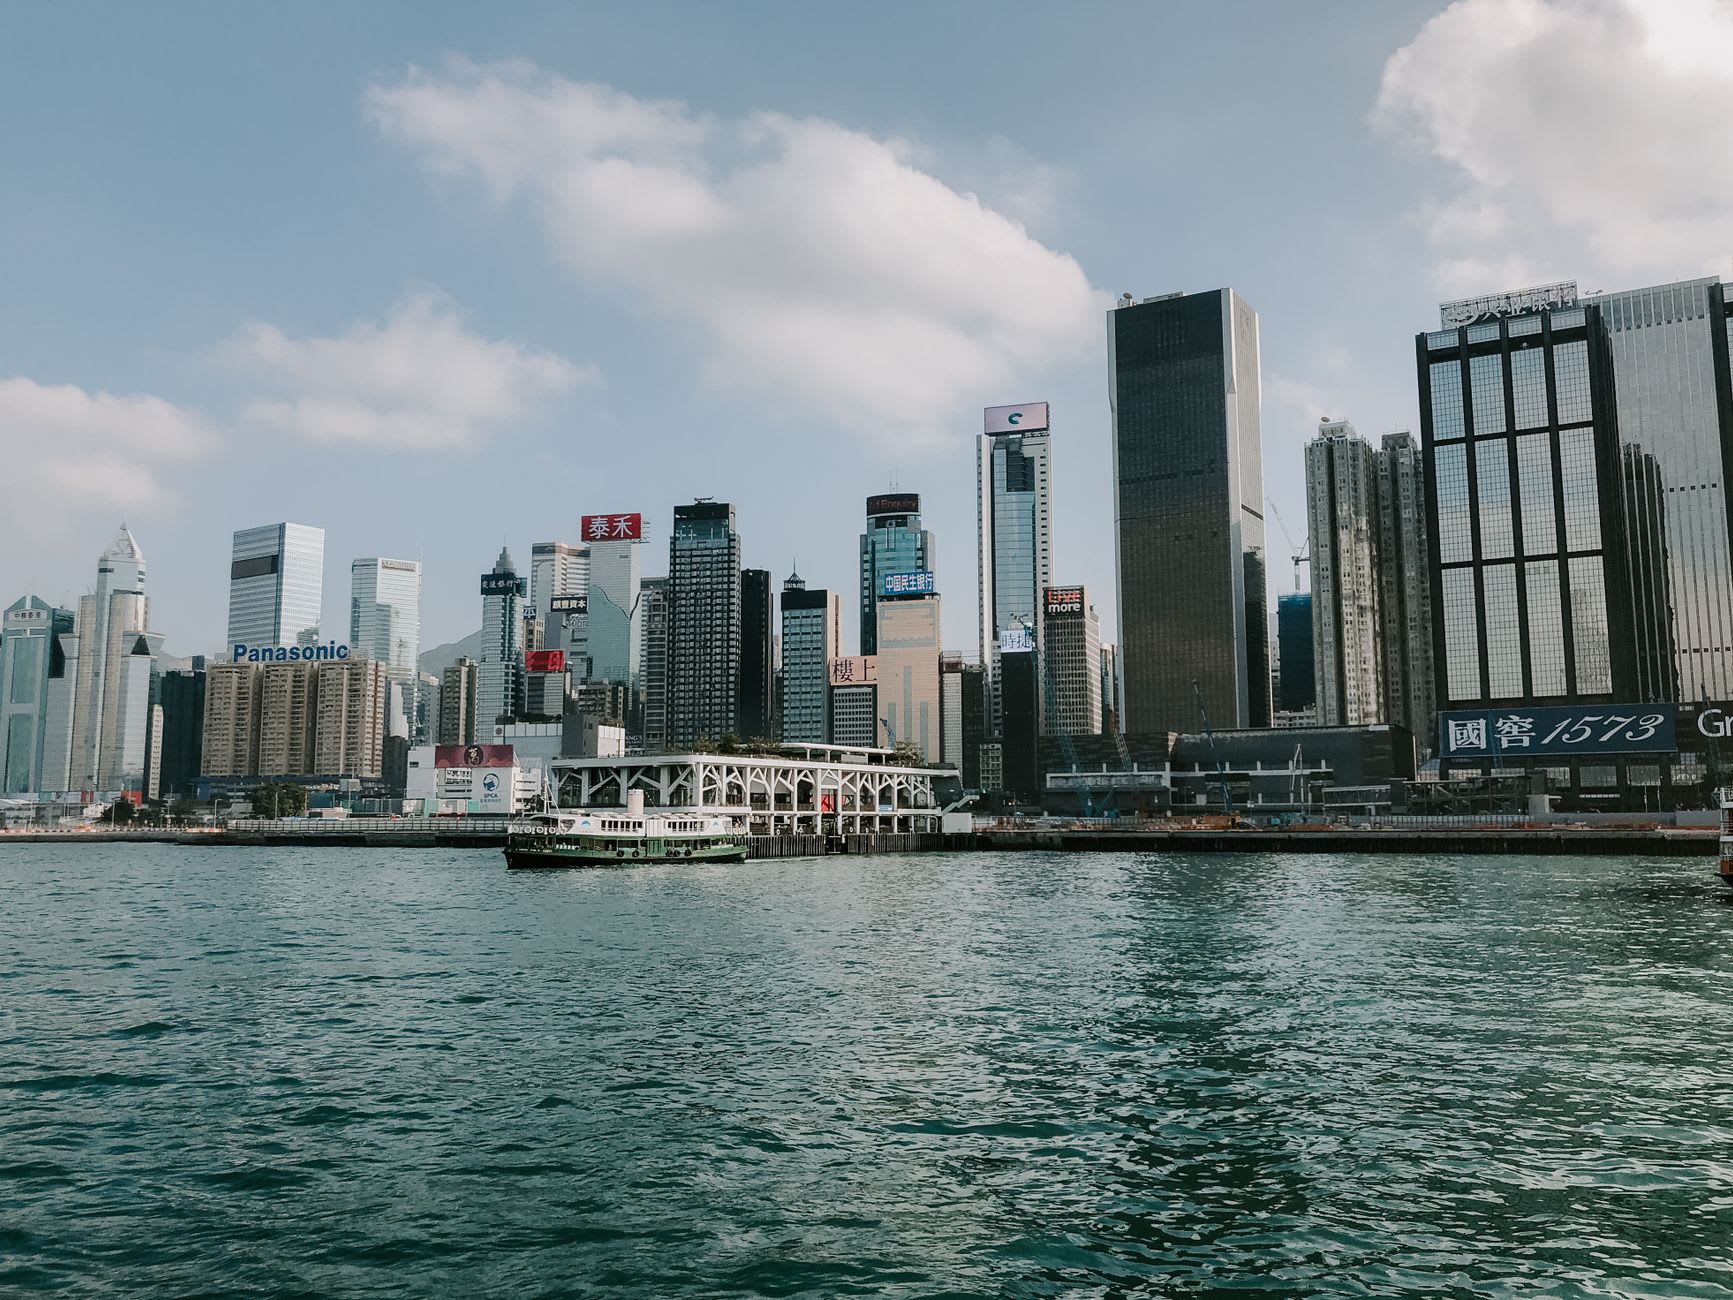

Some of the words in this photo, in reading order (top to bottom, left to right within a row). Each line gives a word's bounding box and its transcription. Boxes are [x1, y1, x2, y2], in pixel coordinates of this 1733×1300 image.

[589, 516, 633, 539] 泰禾
[1048, 603, 1081, 613] more
[233, 640, 349, 663] Panasonic
[832, 658, 878, 684] 樓上
[1447, 715, 1536, 752] 國窖
[1541, 714, 1665, 745] 1573
